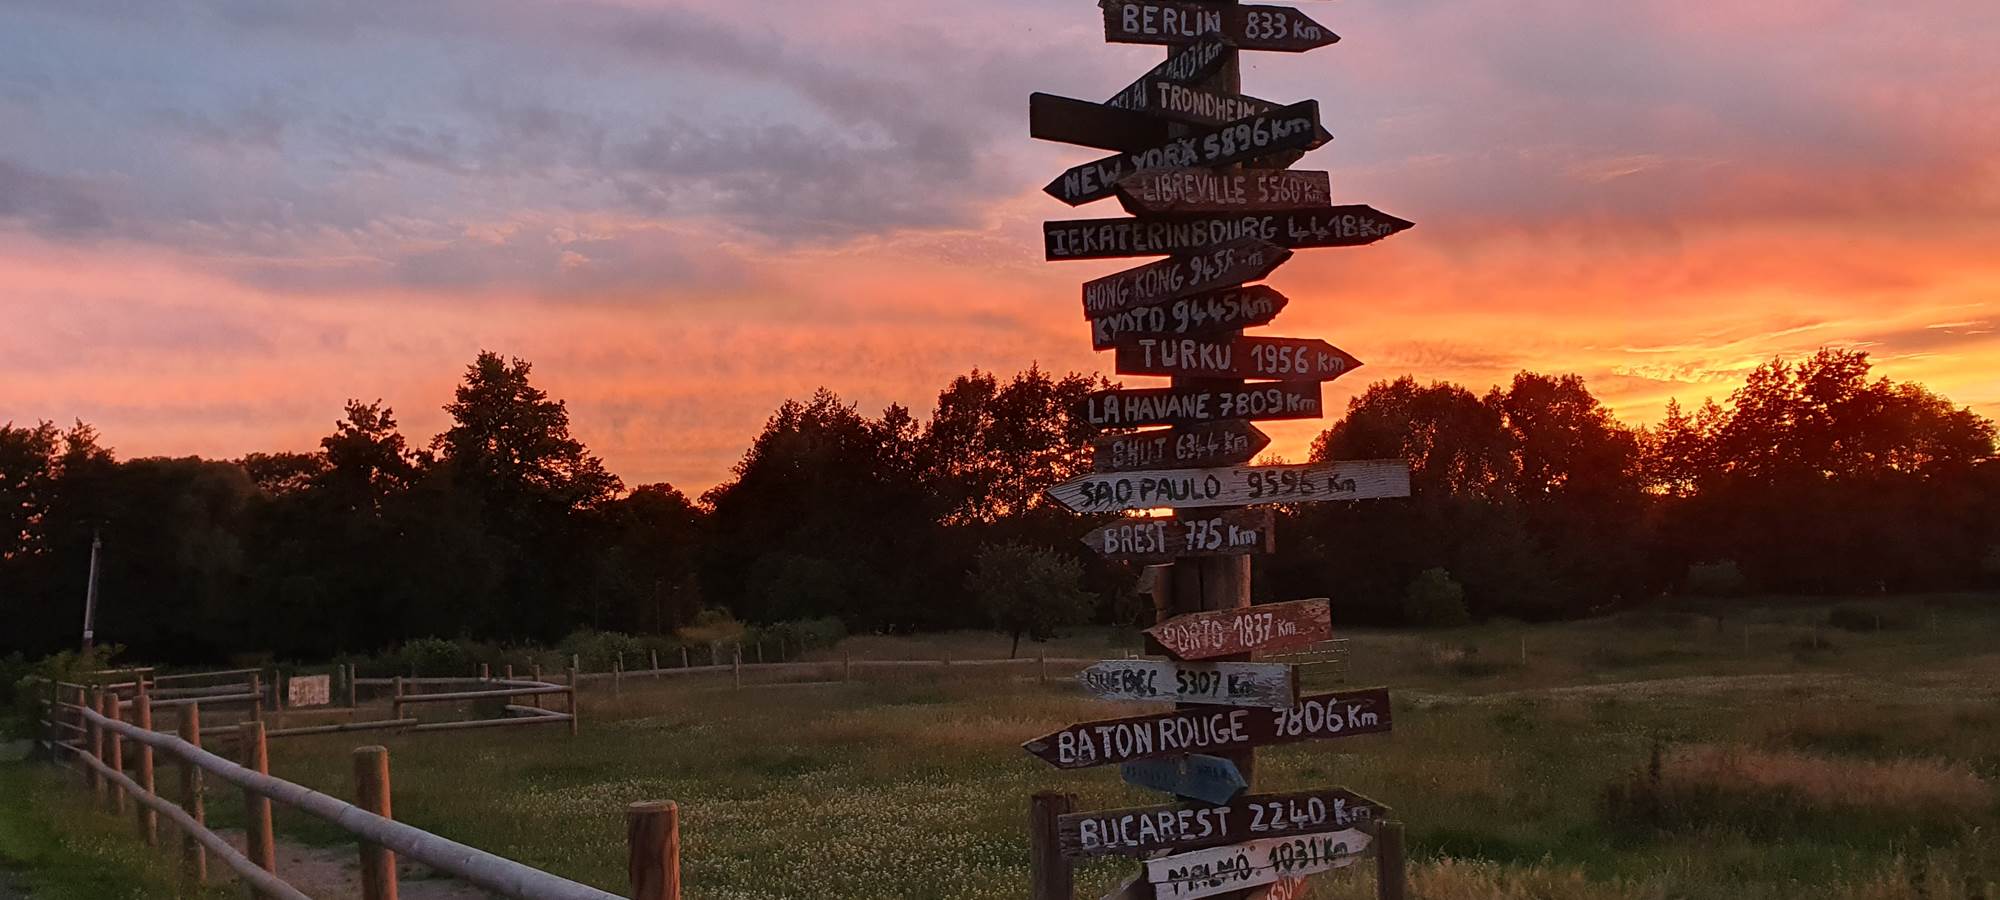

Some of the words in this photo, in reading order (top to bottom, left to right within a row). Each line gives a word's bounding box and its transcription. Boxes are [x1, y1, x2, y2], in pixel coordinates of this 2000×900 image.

[1122, 4, 1221, 37] BERLIN
[1245, 11, 1286, 40] 833
[1294, 19, 1321, 42] Km
[1157, 81, 1255, 122] TRONDHEIM
[1063, 160, 1122, 198] NEW
[1131, 138, 1199, 169] YORK
[1203, 118, 1270, 159] 5896
[1271, 116, 1313, 140] Km
[1143, 172, 1246, 204] LIBREVILLE
[1258, 175, 1299, 203] 5560
[1288, 214, 1357, 241] 4418
[1357, 213, 1392, 237] Km
[1086, 277, 1129, 311] HONG
[1135, 264, 1184, 297] KONG
[1094, 306, 1165, 344] KYOTO
[1172, 295, 1239, 333] 9445
[1240, 296, 1272, 319] Km
[1251, 344, 1309, 373] 1956
[1318, 353, 1345, 372] Km
[1088, 394, 1120, 424] LA
[1219, 388, 1283, 417] 7809
[1286, 393, 1318, 412] Km
[1140, 475, 1221, 502] PAULO
[1104, 520, 1165, 554] BREST
[1184, 518, 1223, 551] 775
[1228, 525, 1257, 547] Km
[1164, 620, 1223, 652] PORTO
[1233, 613, 1273, 647] 1837
[1276, 619, 1297, 637] Km
[1176, 670, 1221, 697] 5307
[1058, 724, 1152, 764] BATON
[1160, 710, 1249, 748] ROUGE
[1273, 698, 1344, 738] 7806
[1348, 706, 1377, 728] Km
[1080, 807, 1231, 850] BUCAREST
[1249, 800, 1325, 832] 2240
[1334, 799, 1371, 826] Km
[1269, 836, 1318, 872] 1031
